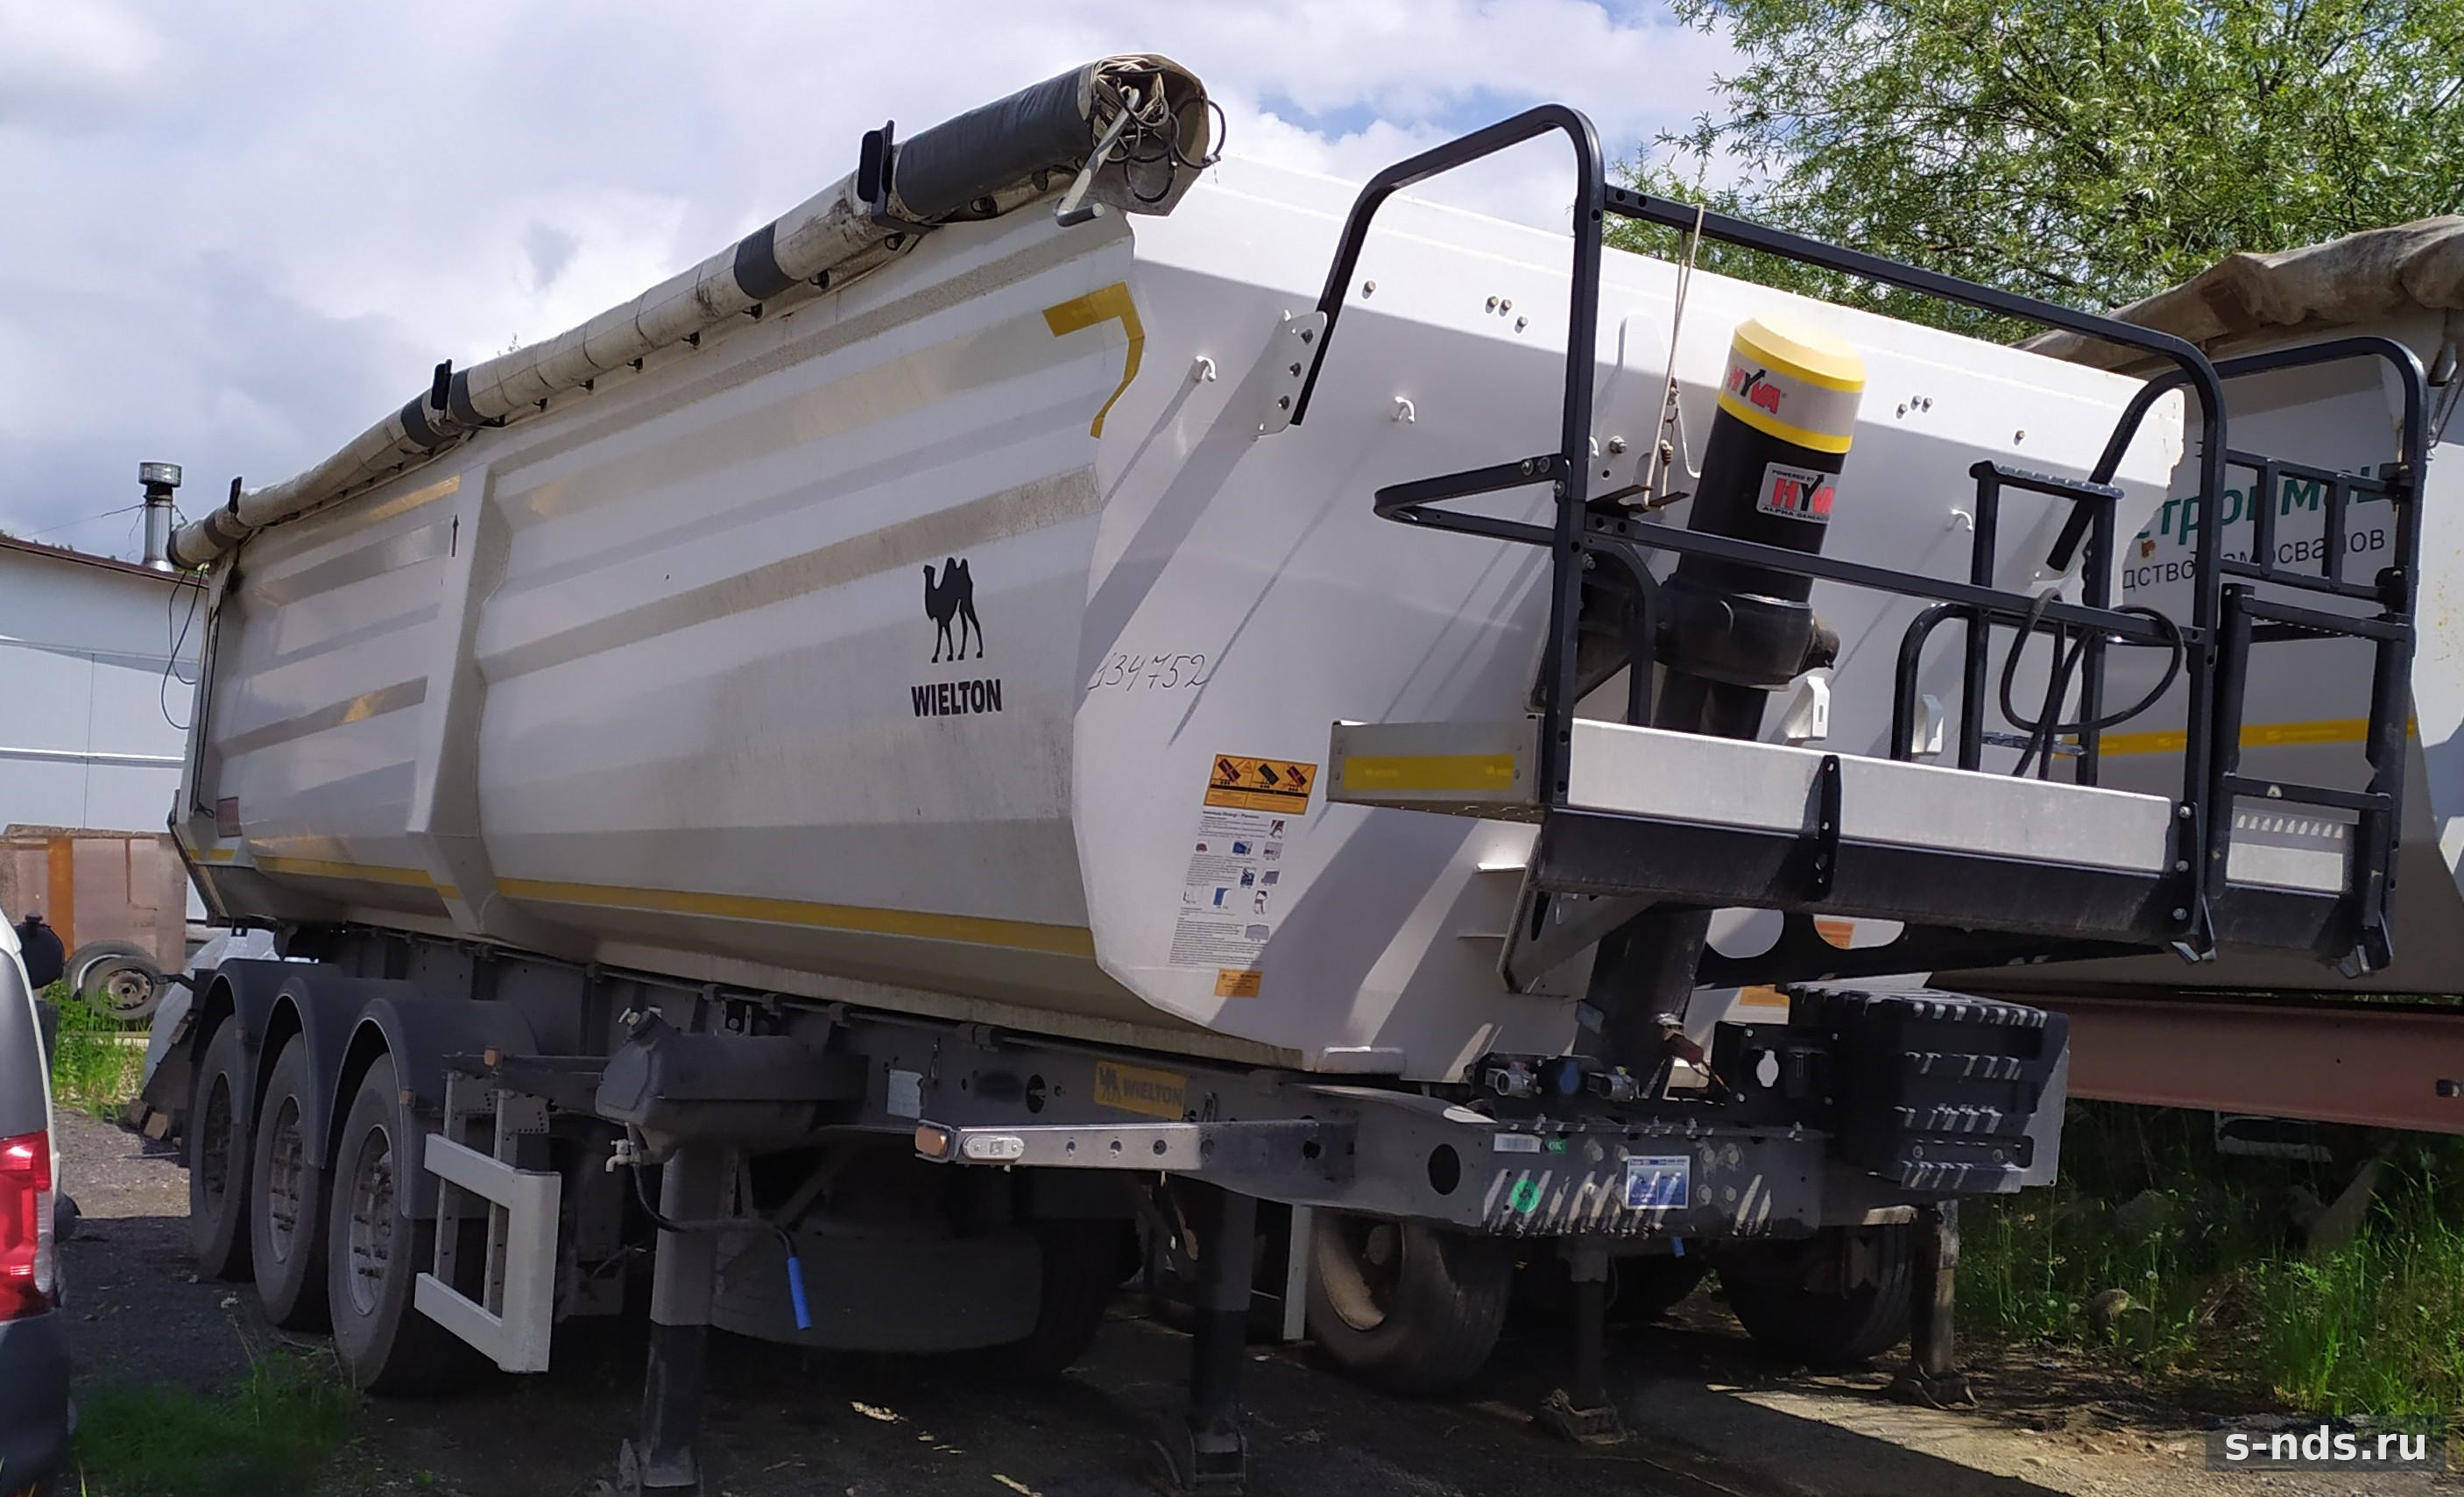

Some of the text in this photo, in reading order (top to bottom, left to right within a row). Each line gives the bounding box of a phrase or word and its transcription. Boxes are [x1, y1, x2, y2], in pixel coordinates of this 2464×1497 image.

[1726, 365, 1782, 414] HYVA
[911, 679, 1002, 717] WIELTON
[1123, 1077, 1183, 1107] WIELTON
[1548, 1141, 1563, 1152] OK
